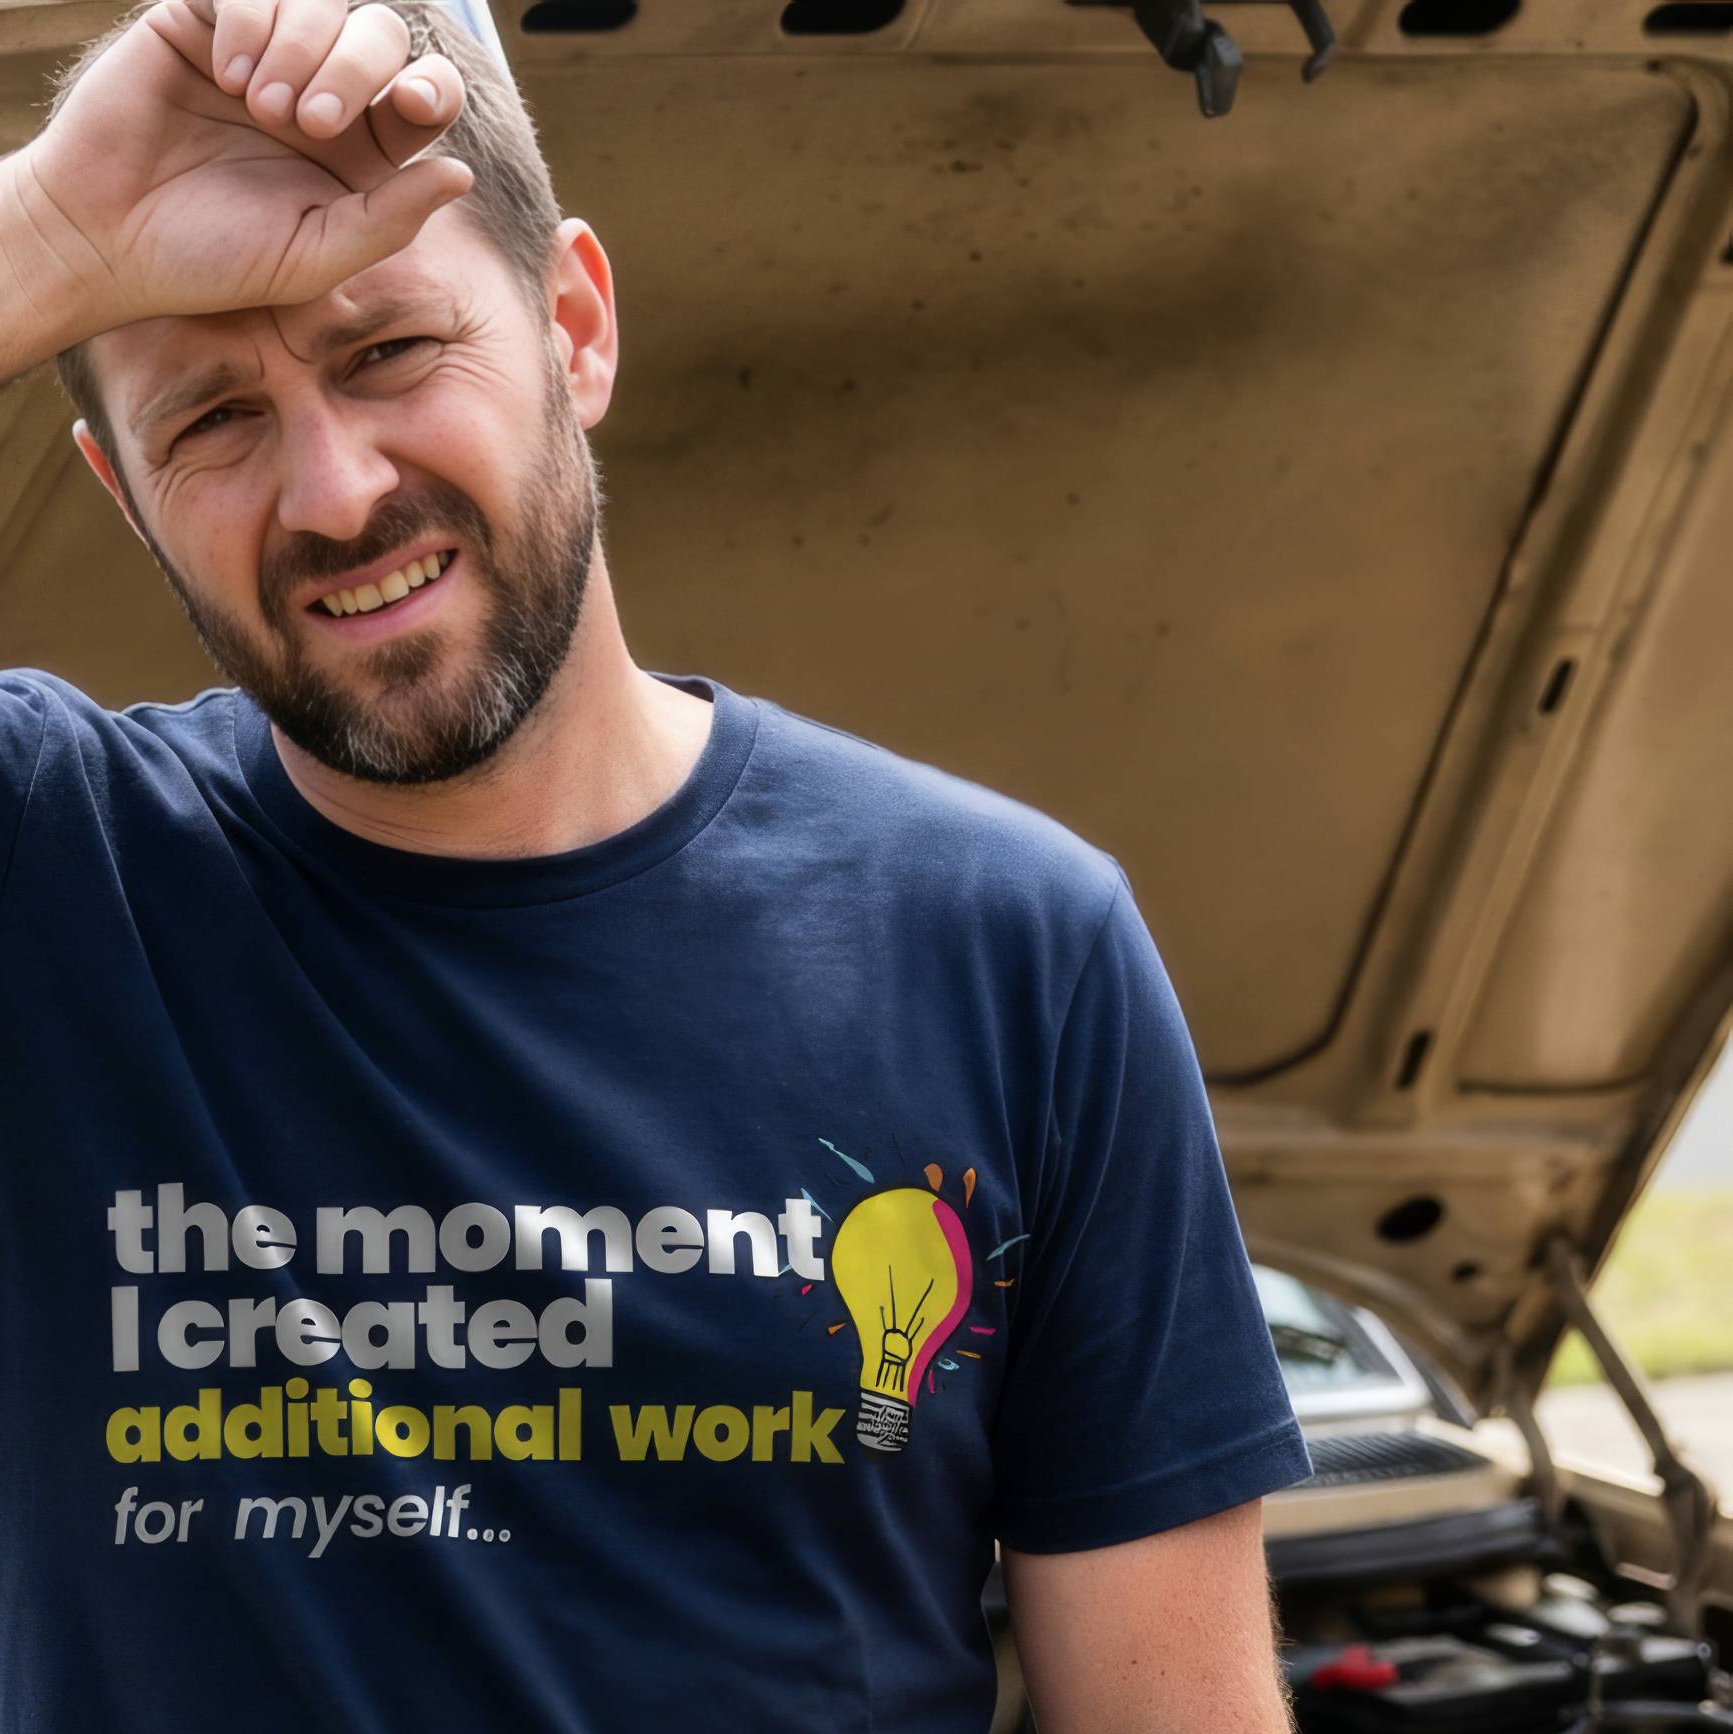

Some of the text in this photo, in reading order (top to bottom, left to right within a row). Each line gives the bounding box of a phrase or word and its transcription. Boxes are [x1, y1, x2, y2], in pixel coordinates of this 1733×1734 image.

[107, 1182, 826, 1281] the moment
[111, 1278, 613, 1372] I created
[105, 1377, 846, 1464] additional work
[114, 1483, 511, 1559] for myself...
